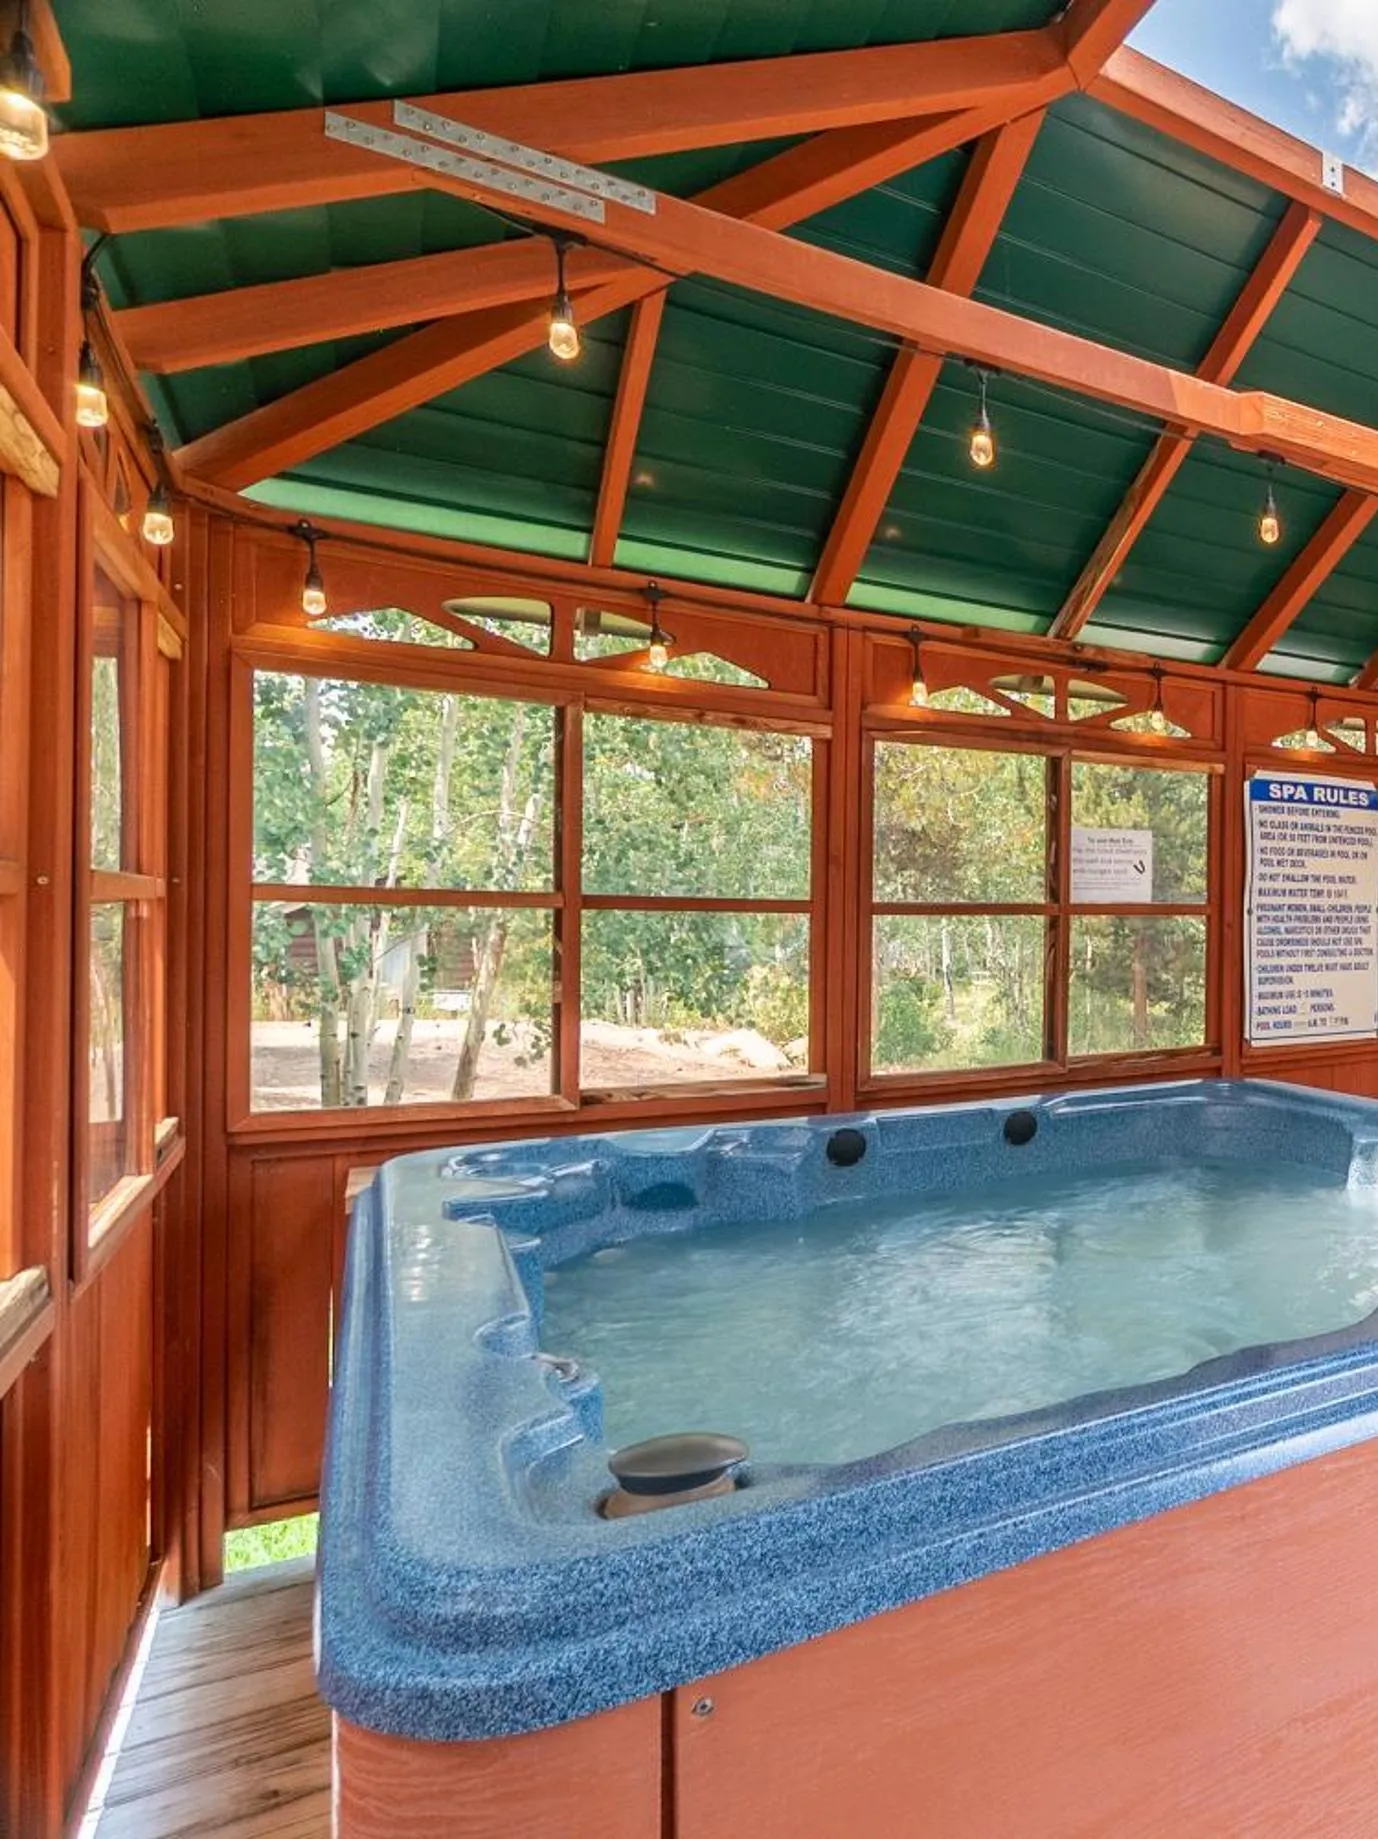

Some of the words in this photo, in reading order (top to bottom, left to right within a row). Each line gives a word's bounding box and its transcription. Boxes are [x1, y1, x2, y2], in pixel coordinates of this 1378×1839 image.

[1269, 784, 1308, 800] SPA
[1314, 786, 1369, 806] RULES
[1290, 822, 1298, 831] OR
[1300, 823, 1324, 832] ANIMALS
[1333, 824, 1342, 834] THE
[1296, 834, 1310, 842] FEET
[1312, 834, 1326, 843] FROM
[1270, 847, 1285, 856] FOOD
[1288, 848, 1294, 856] OR
[1296, 849, 1328, 857] BEVERAGES
[1330, 850, 1335, 858] IN
[1337, 850, 1350, 859] POOL
[1260, 858, 1274, 868] POOL
[1276, 859, 1288, 868] WET
[1270, 873, 1280, 881] NOT
[1282, 874, 1308, 882] SWALLOW
[1310, 874, 1321, 883] THE
[1323, 874, 1336, 883] POOL
[1310, 904, 1325, 912] SMALL
[1257, 915, 1270, 923] WITH
[1323, 915, 1332, 923] AND
[1334, 915, 1352, 923] PEOPLE
[1323, 926, 1339, 934] OTHER
[1332, 937, 1342, 945] NOT
[1282, 1005, 1297, 1014] LOAD
